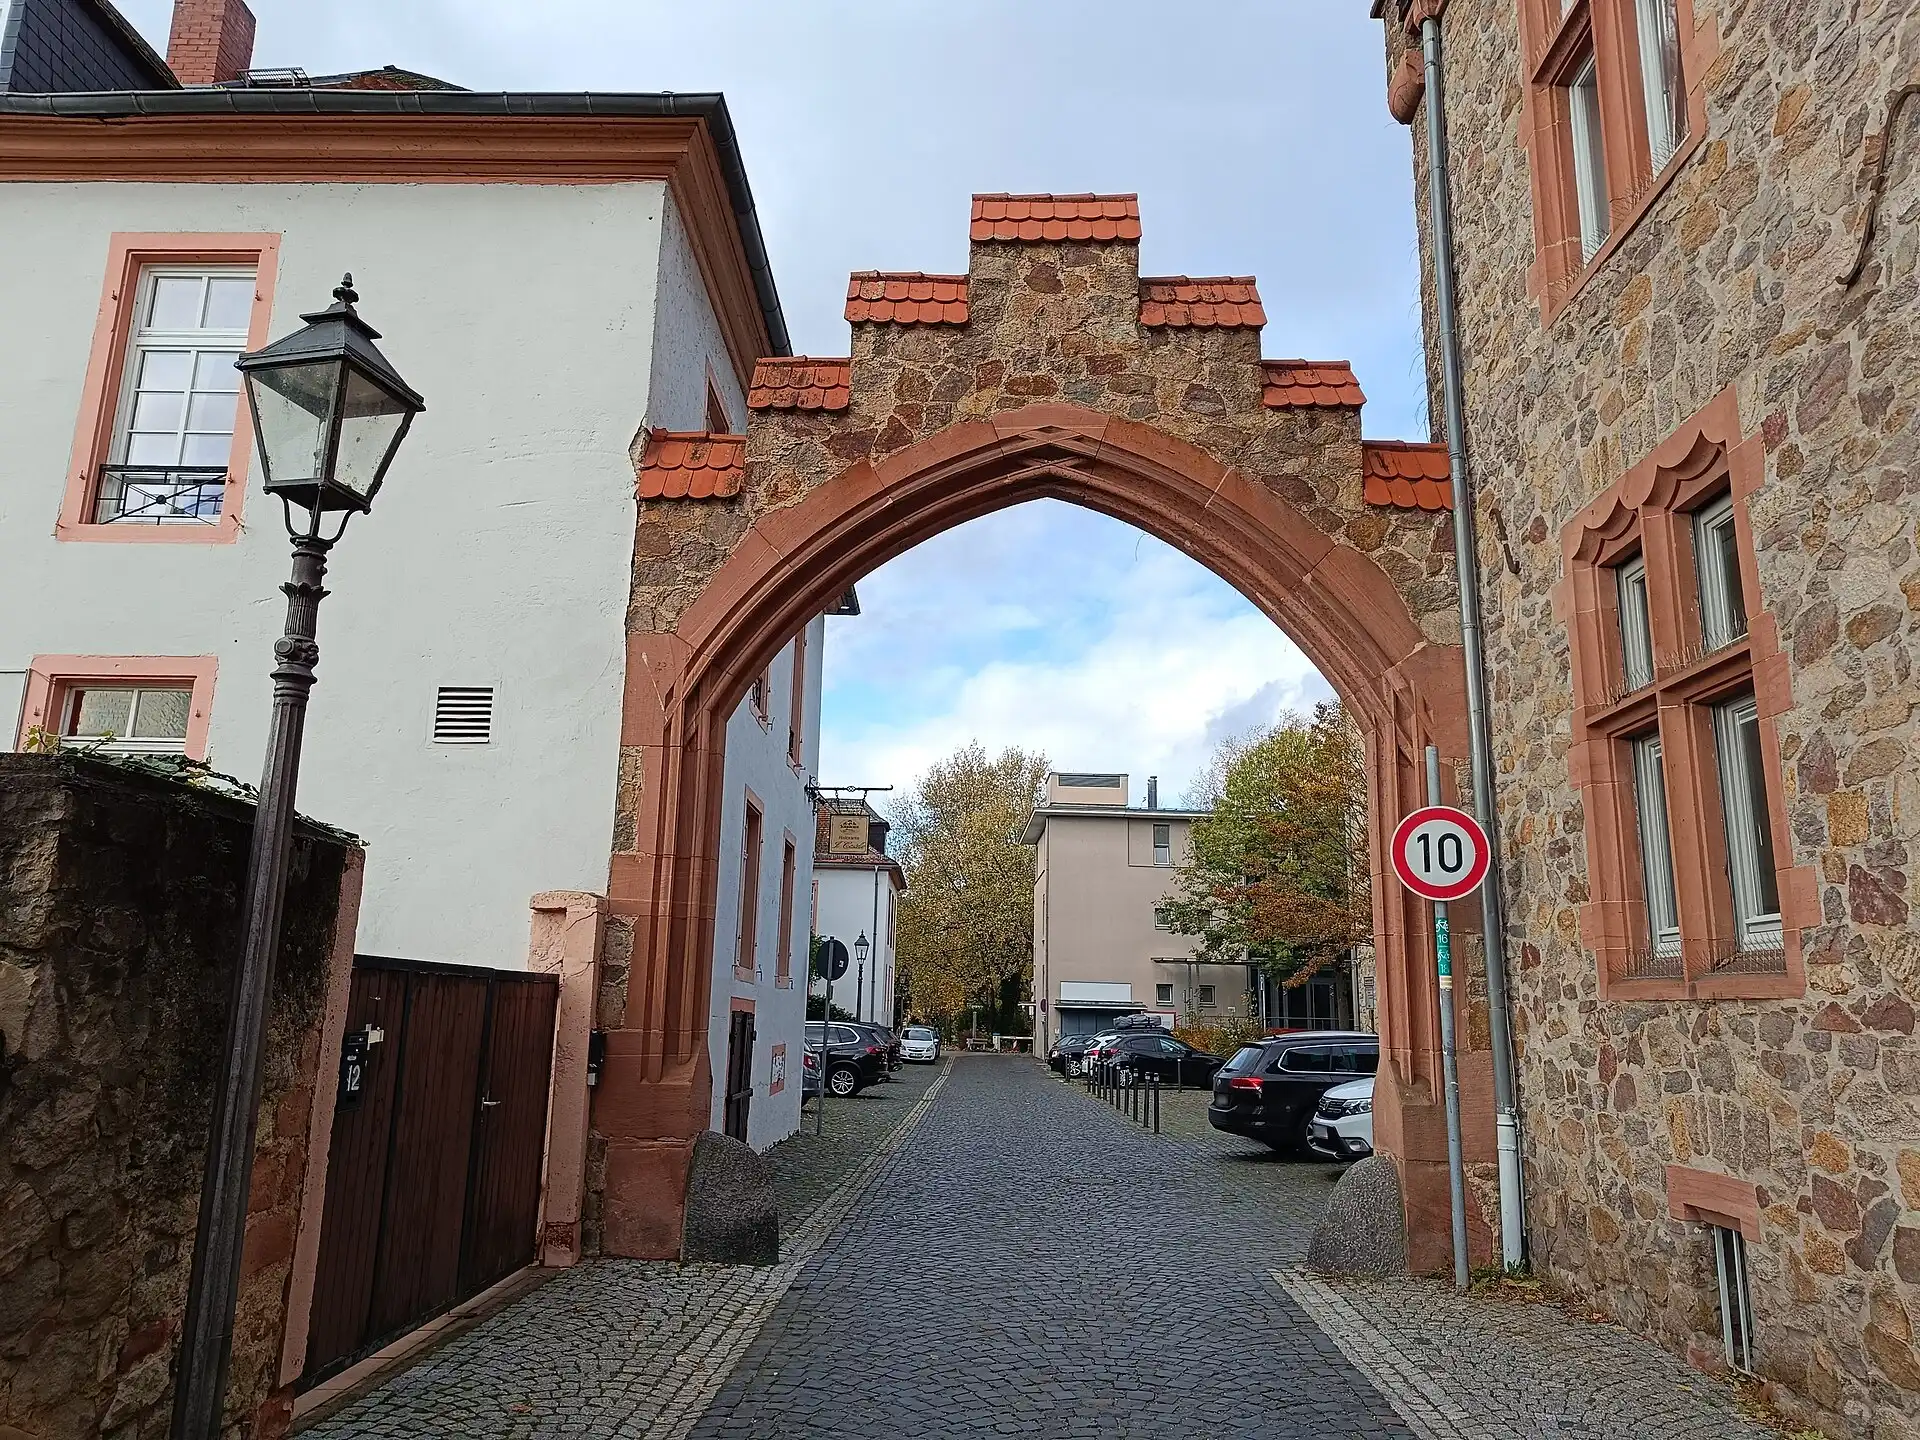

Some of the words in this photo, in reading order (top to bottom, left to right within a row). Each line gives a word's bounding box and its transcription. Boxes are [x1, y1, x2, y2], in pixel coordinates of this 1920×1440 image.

[1416, 832, 1463, 873] 10
[1437, 933, 1449, 944] 16
[1440, 963, 1450, 974] 18
[346, 1064, 361, 1092] 12
